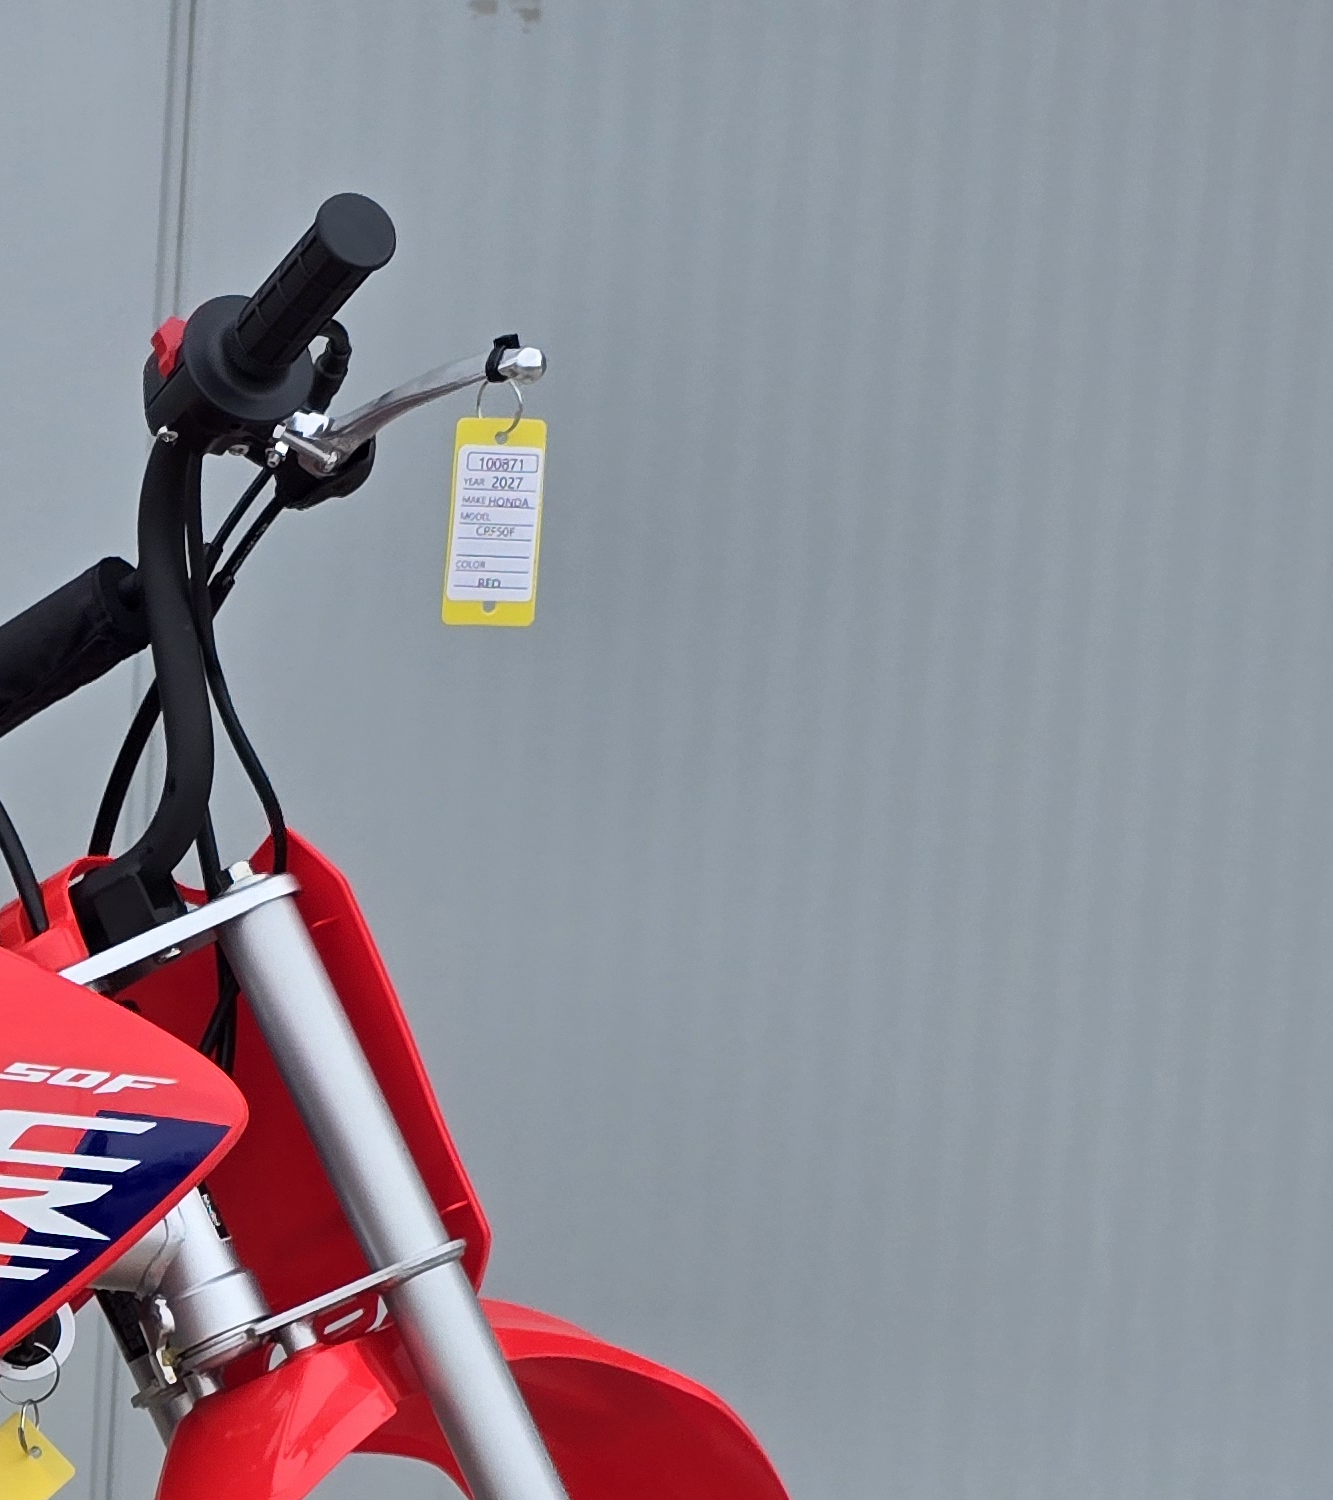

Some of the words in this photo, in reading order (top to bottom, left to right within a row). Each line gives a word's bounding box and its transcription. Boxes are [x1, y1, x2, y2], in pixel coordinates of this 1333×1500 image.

[478, 456, 525, 472] 100871
[463, 477, 485, 487] YEAR
[490, 475, 524, 490] 2027
[461, 495, 486, 505] MAKE
[487, 497, 530, 508] HONDA
[459, 512, 491, 522] MODEL
[455, 560, 485, 569] COLOR
[476, 577, 502, 589] RED
